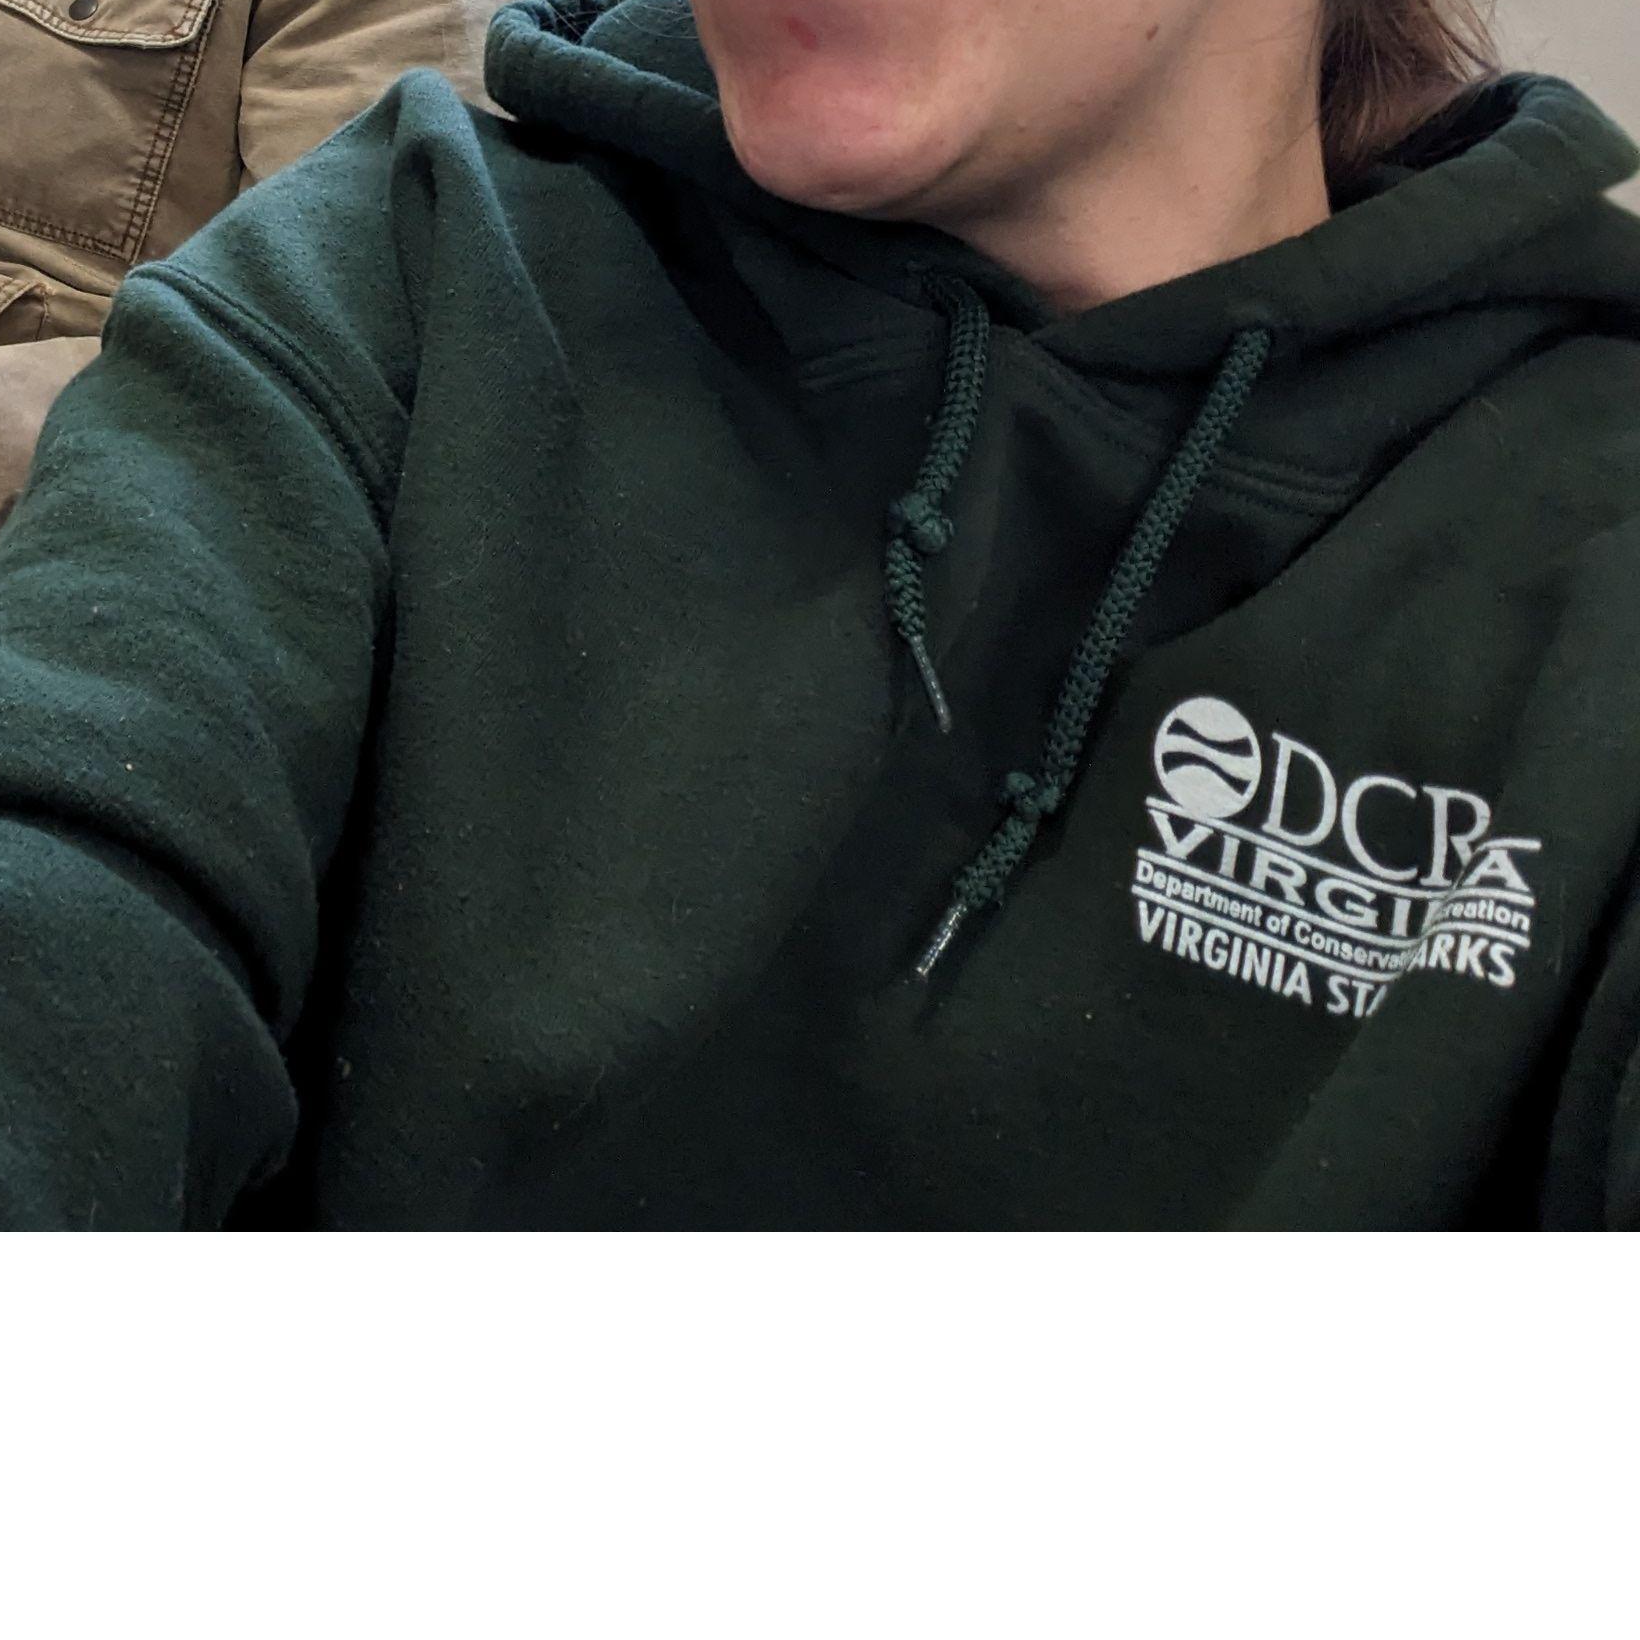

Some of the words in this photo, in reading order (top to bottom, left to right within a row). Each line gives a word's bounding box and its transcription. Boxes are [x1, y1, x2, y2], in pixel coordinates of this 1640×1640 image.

[1262, 731, 1491, 888] DCR
[1136, 859, 1263, 927] Department
[1266, 913, 1291, 937] of
[1138, 900, 1313, 1005] VIRGINIA
[1407, 933, 1516, 989] ARKS
